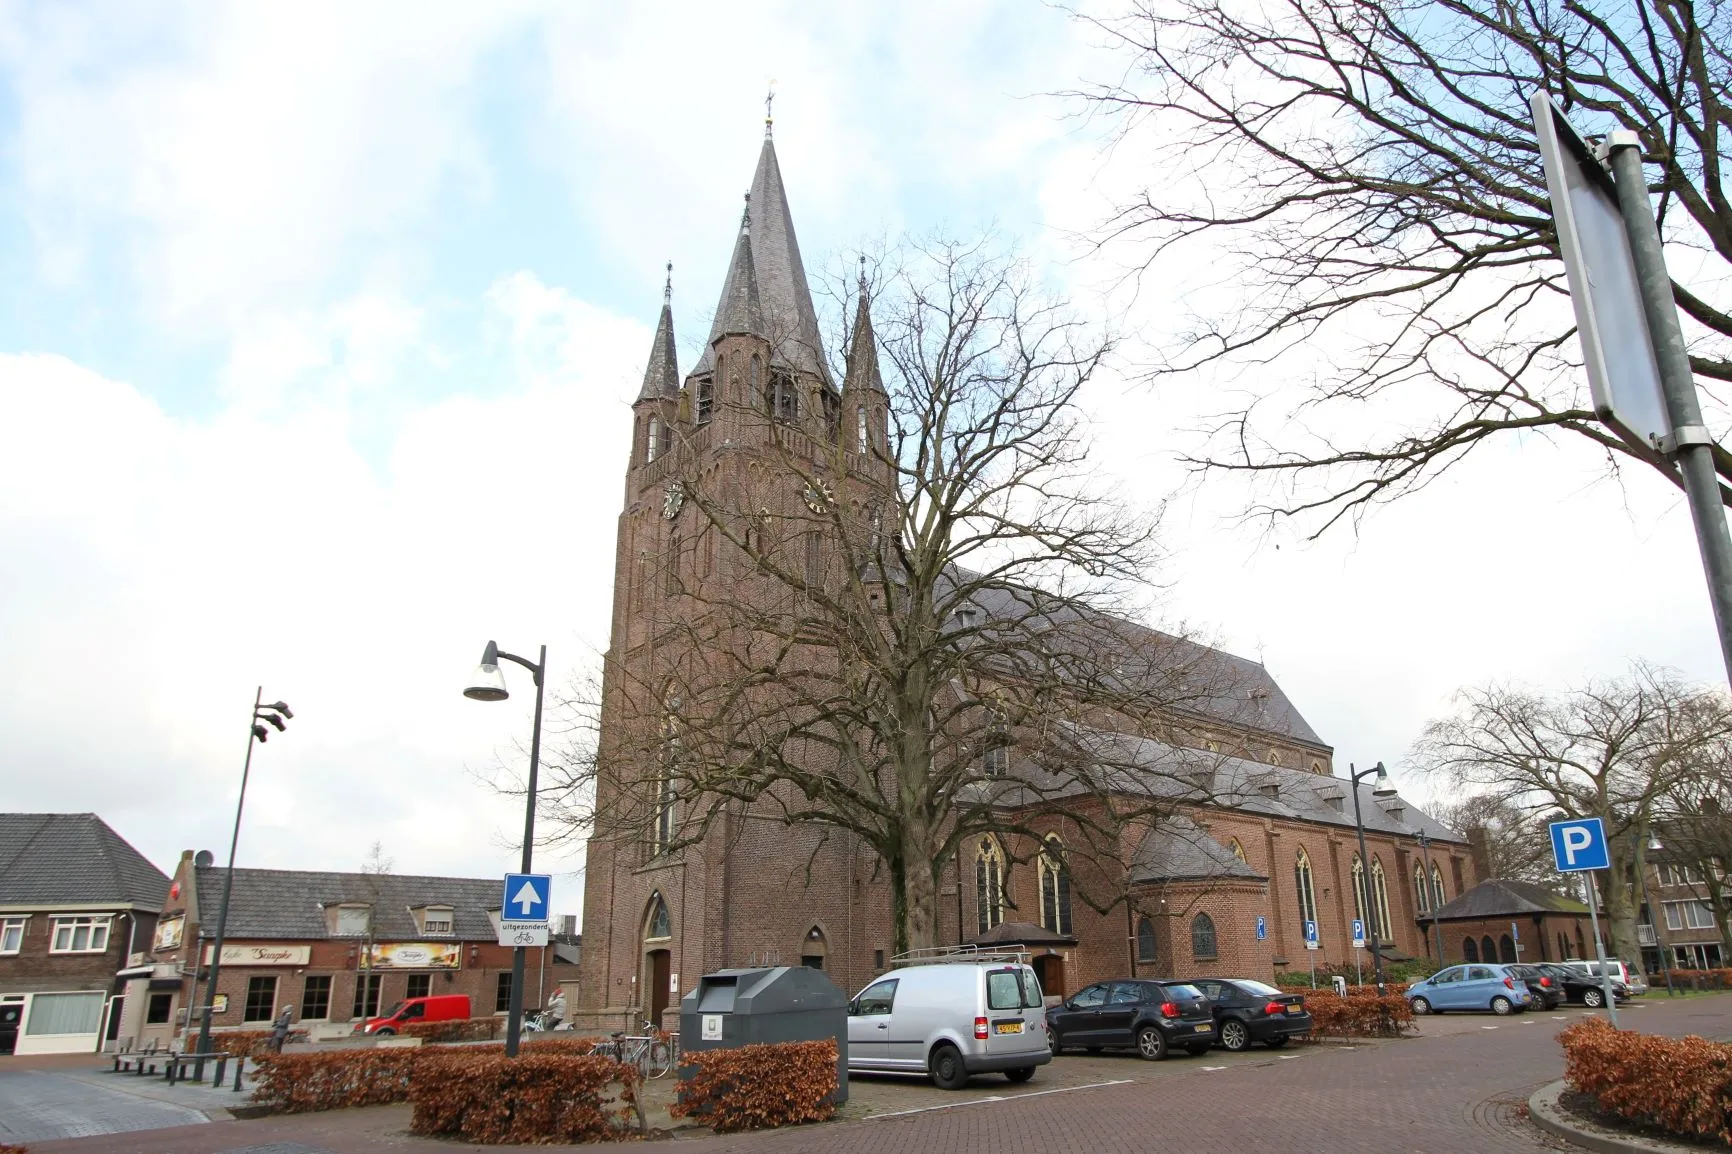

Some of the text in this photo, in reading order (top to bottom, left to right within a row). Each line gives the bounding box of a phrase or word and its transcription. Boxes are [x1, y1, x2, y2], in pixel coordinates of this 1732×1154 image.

[1562, 826, 1592, 865] P
[502, 923, 548, 931] uitgezonderd
[1308, 923, 1315, 940] P
[1354, 922, 1361, 938] P
